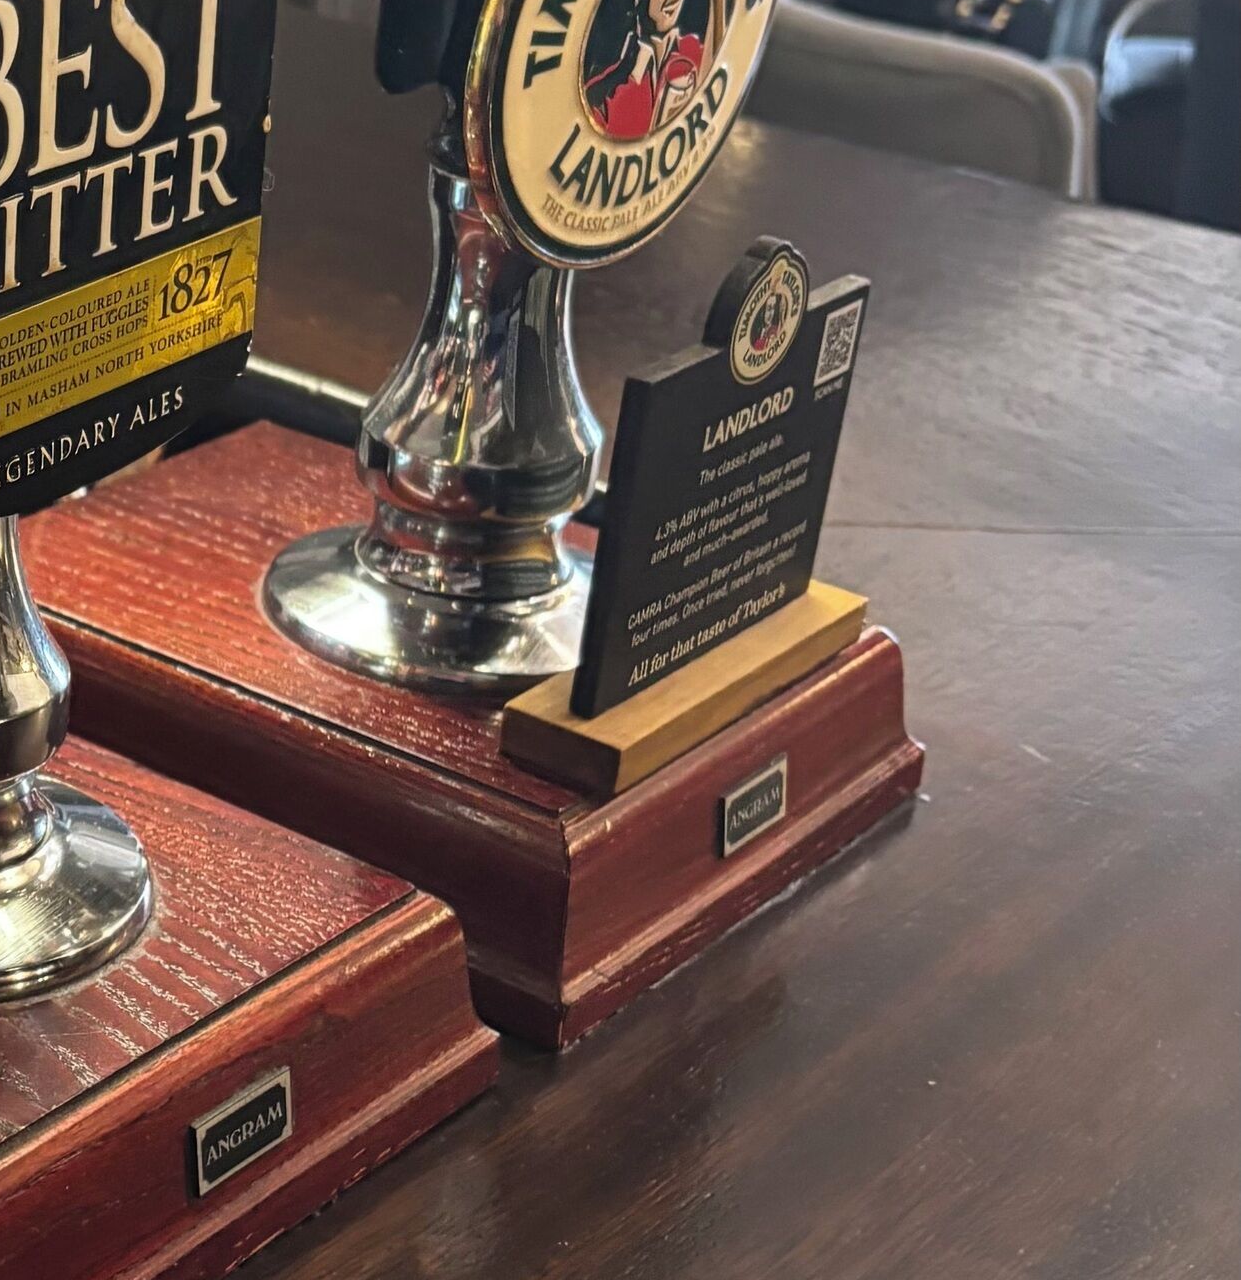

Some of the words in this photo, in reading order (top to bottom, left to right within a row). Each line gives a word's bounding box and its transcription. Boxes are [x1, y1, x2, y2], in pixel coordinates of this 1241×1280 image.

[549, 67, 728, 208] LANDLORD
[541, 193, 565, 220] THE
[564, 210, 610, 233] CLASSIC
[612, 207, 639, 230] PALE
[127, 278, 150, 300] ALE
[158, 248, 233, 321] 1827
[738, 278, 772, 343] TIMOTHY
[50, 319, 87, 348] WITH
[91, 296, 149, 337] FUGGLES
[0, 349, 68, 387] BRAMLING
[72, 328, 112, 356] CROSS
[116, 314, 148, 338] HOPS
[5, 401, 21, 418] IN
[28, 368, 90, 408] MASHAM
[95, 347, 145, 380] NORTH
[149, 312, 223, 354] YORKSHIRE
[743, 331, 786, 367] LANDLORD
[129, 385, 183, 431] ALES
[703, 386, 794, 452] LANDLORD
[699, 469, 715, 486] The
[717, 451, 747, 478] classic
[650, 543, 670, 565] and
[670, 528, 696, 554] depth
[697, 522, 708, 539] of
[655, 518, 678, 541] 4.3%
[679, 506, 701, 529] ABV
[701, 497, 719, 518] with
[683, 545, 702, 567] and
[628, 600, 662, 630] CAMRA
[664, 576, 710, 610] Champion
[710, 563, 732, 584] Beer
[628, 658, 649, 687] All
[650, 651, 671, 674] for
[671, 635, 695, 661] that
[696, 619, 726, 646] taste
[727, 604, 741, 629] of
[631, 628, 653, 647] four
[682, 599, 705, 620] Once
[207, 1101, 283, 1166] ANGRAM
